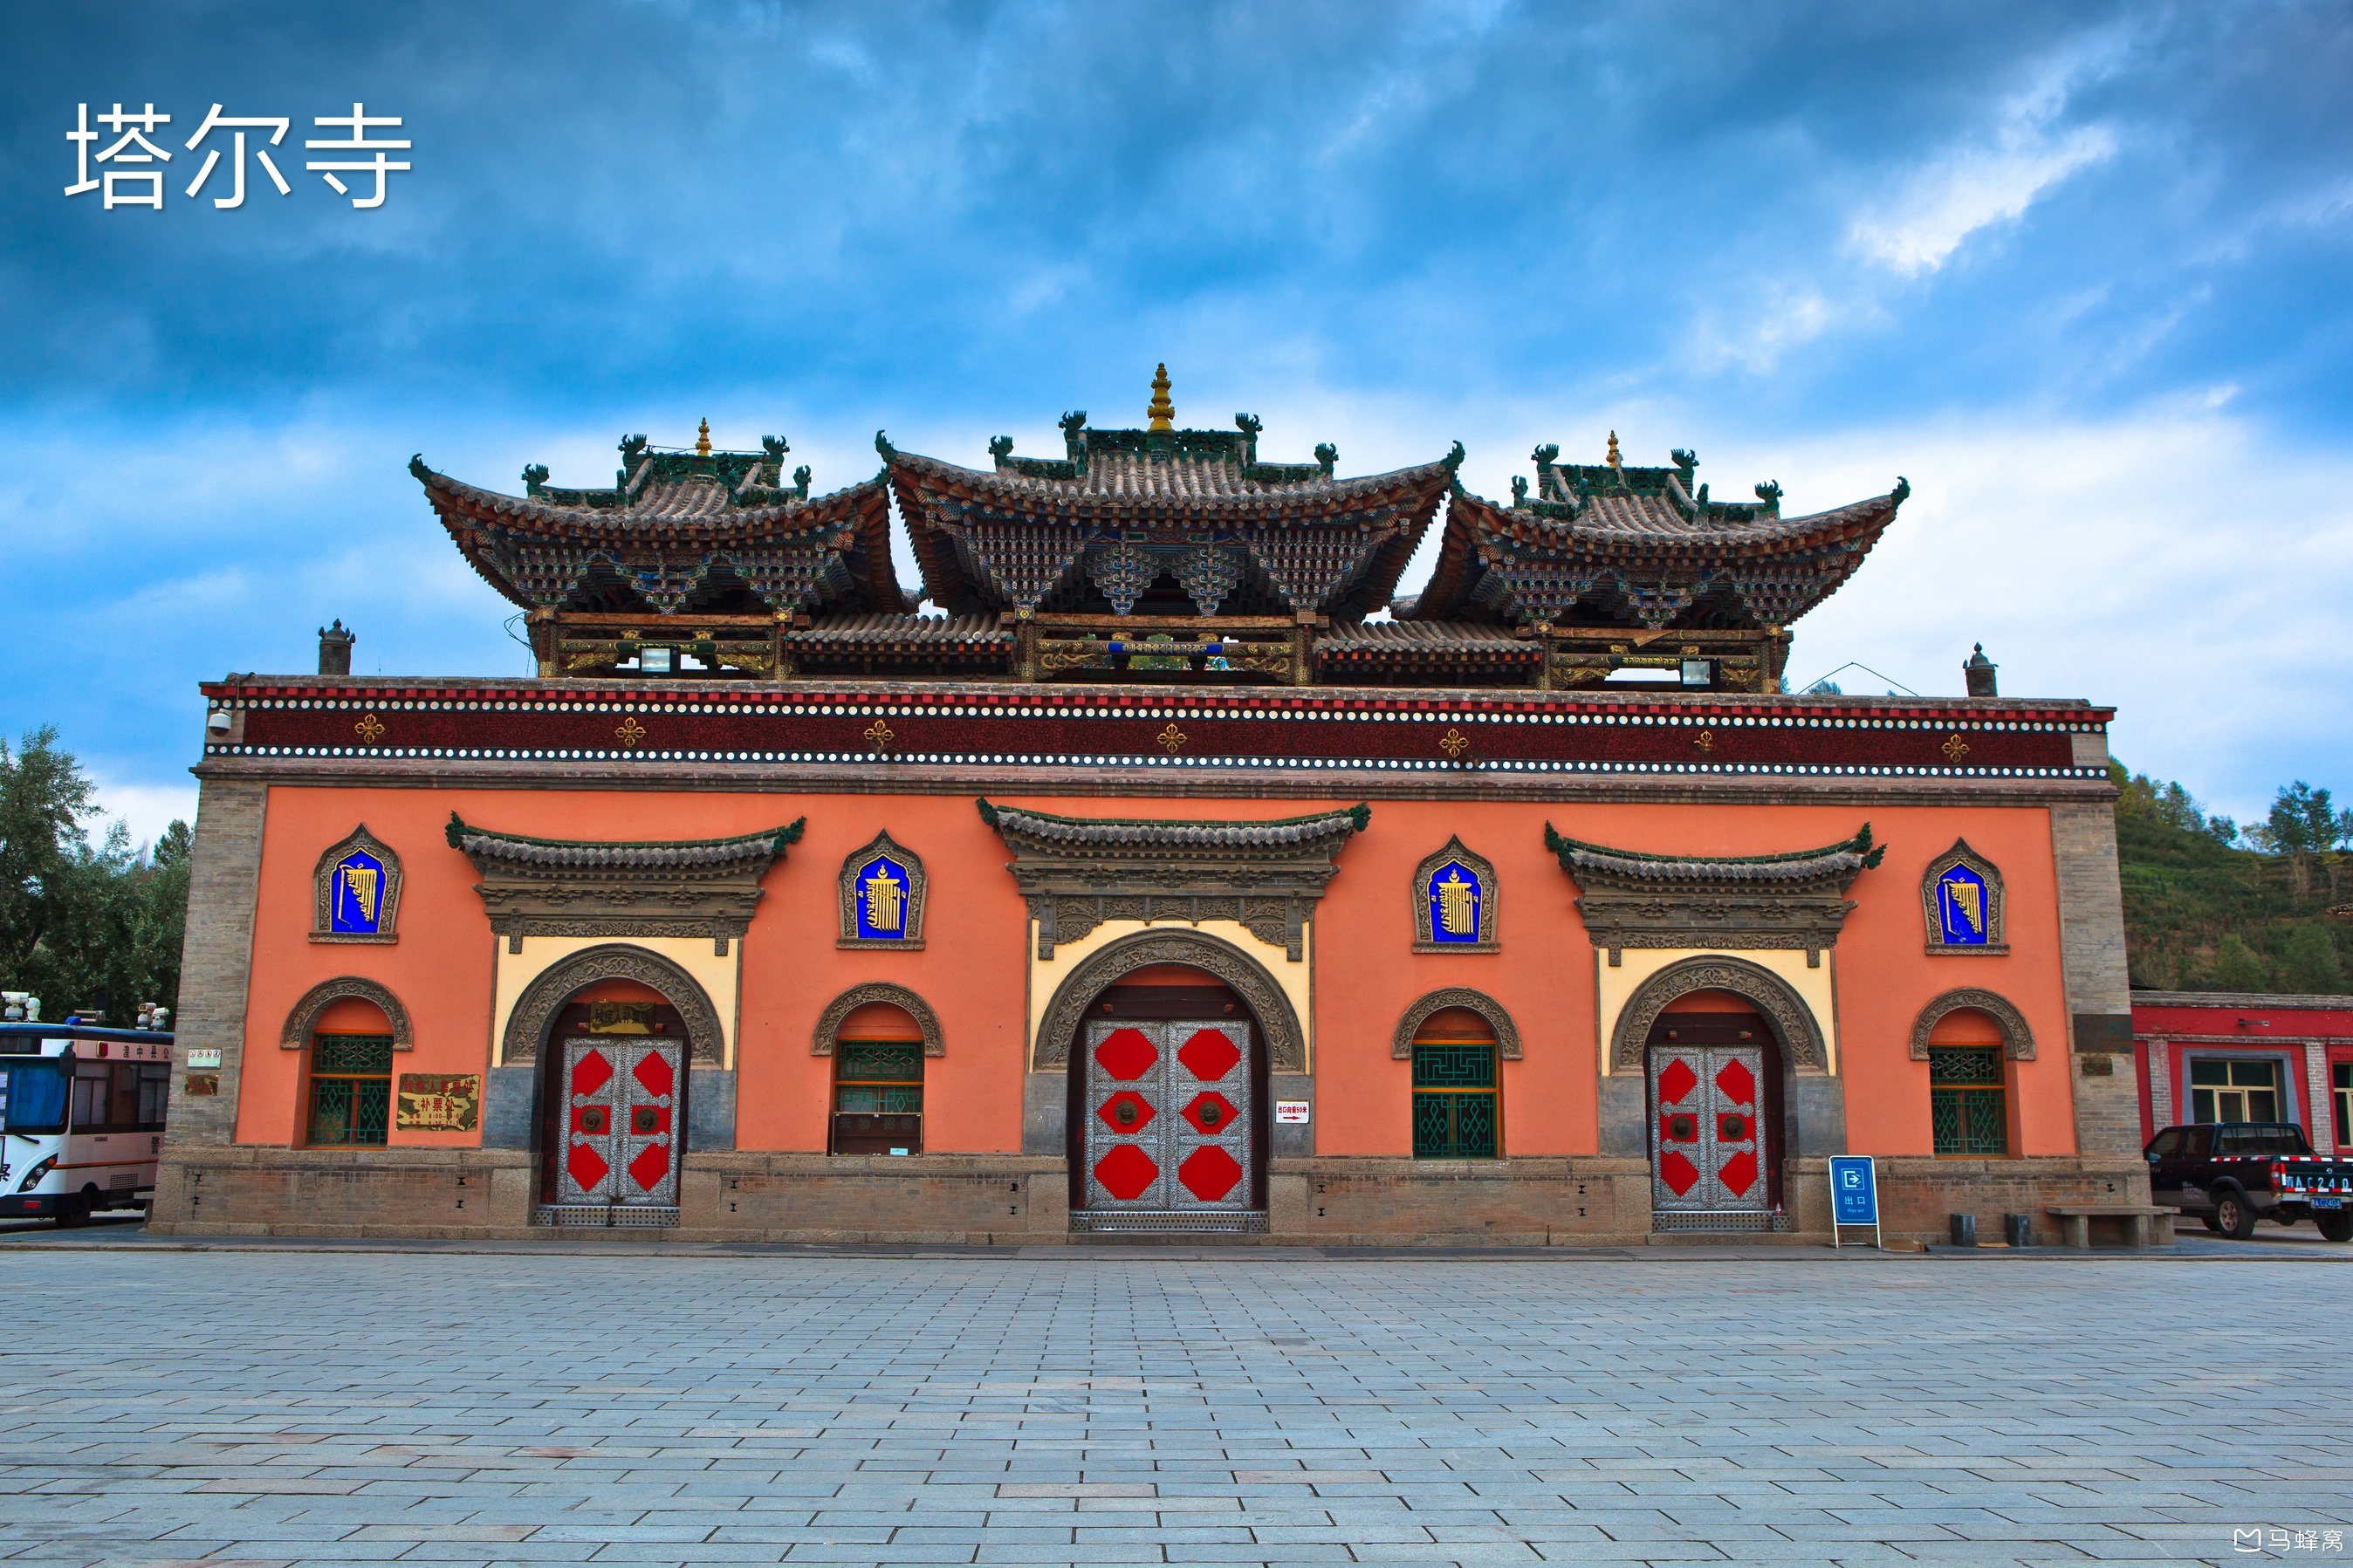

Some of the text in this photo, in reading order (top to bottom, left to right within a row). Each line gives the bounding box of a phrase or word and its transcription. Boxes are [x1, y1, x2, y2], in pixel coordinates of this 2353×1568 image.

[421, 1098, 455, 1112] 补票处
[839, 1117, 913, 1130] 失物招领
[1844, 1195, 1866, 1205] 出口
